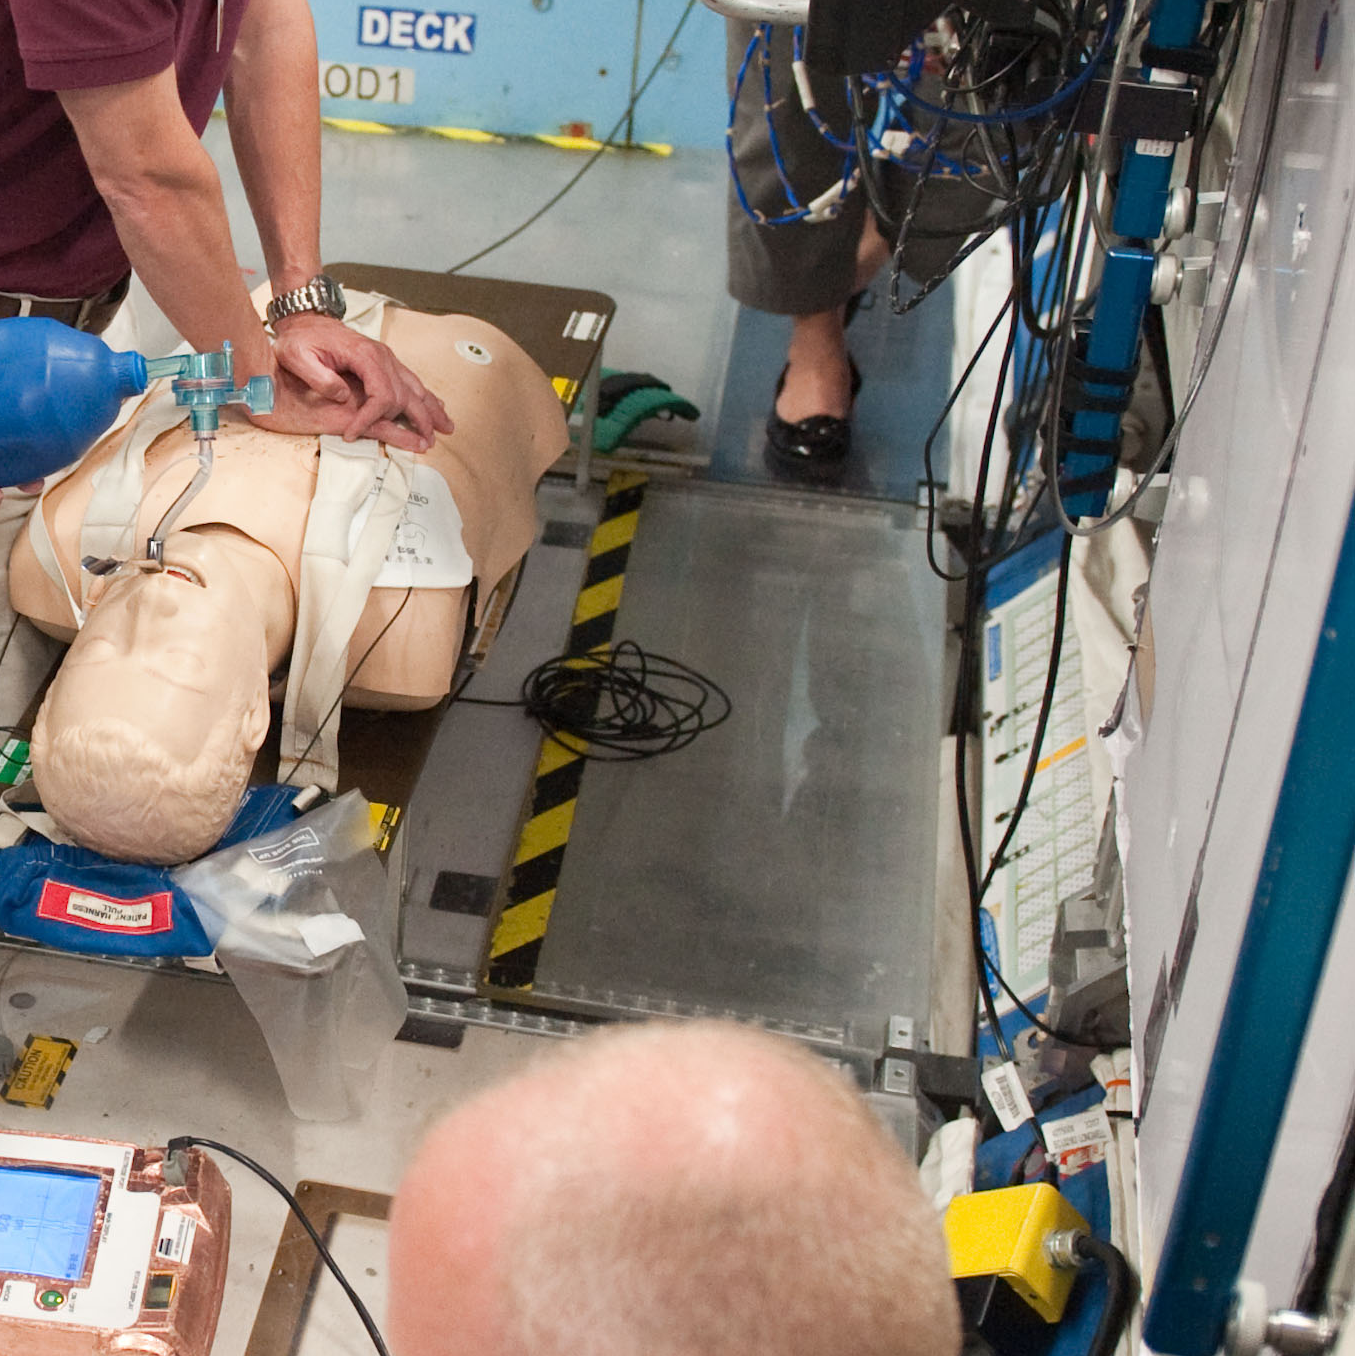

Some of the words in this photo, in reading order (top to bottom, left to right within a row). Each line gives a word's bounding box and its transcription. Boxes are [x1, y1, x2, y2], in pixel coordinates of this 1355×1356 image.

[361, 9, 474, 53] DECK
[72, 903, 112, 920] HARNESS
[102, 905, 124, 914] PULL
[115, 913, 148, 922] PATIENT
[15, 1049, 43, 1090] CAUTION
